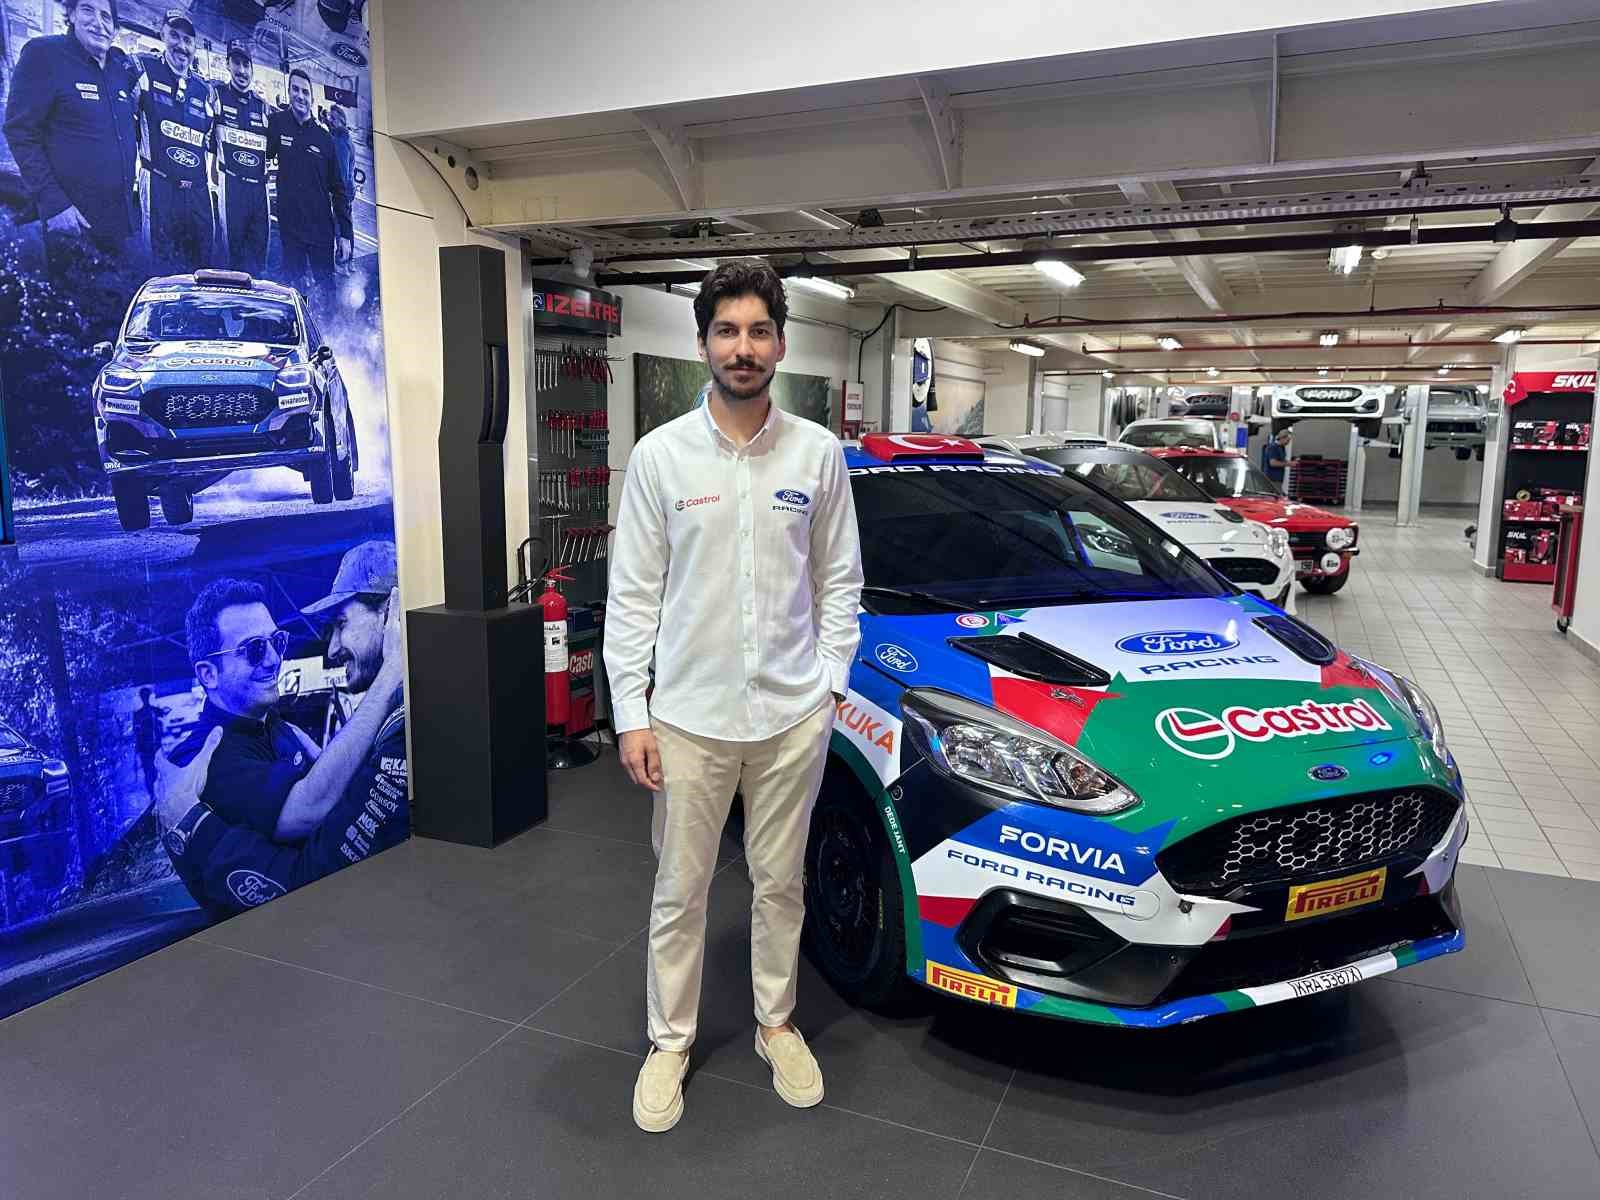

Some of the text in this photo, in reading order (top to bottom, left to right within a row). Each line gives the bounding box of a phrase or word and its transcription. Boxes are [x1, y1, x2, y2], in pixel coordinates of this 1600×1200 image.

[1551, 375, 1596, 388] SKIL
[928, 465, 1065, 478] RACING
[686, 495, 720, 508] Castrol
[880, 644, 910, 671] Ford
[1143, 631, 1221, 653] Ford
[1138, 655, 1280, 675] RACING
[836, 703, 894, 754] KUKA
[1223, 698, 1389, 740] Castrol
[999, 824, 1126, 875] FORVIA
[947, 849, 1137, 907] FORD RACING
[1295, 873, 1381, 914] PIRELLI
[932, 966, 1011, 1007] PIRELLI
